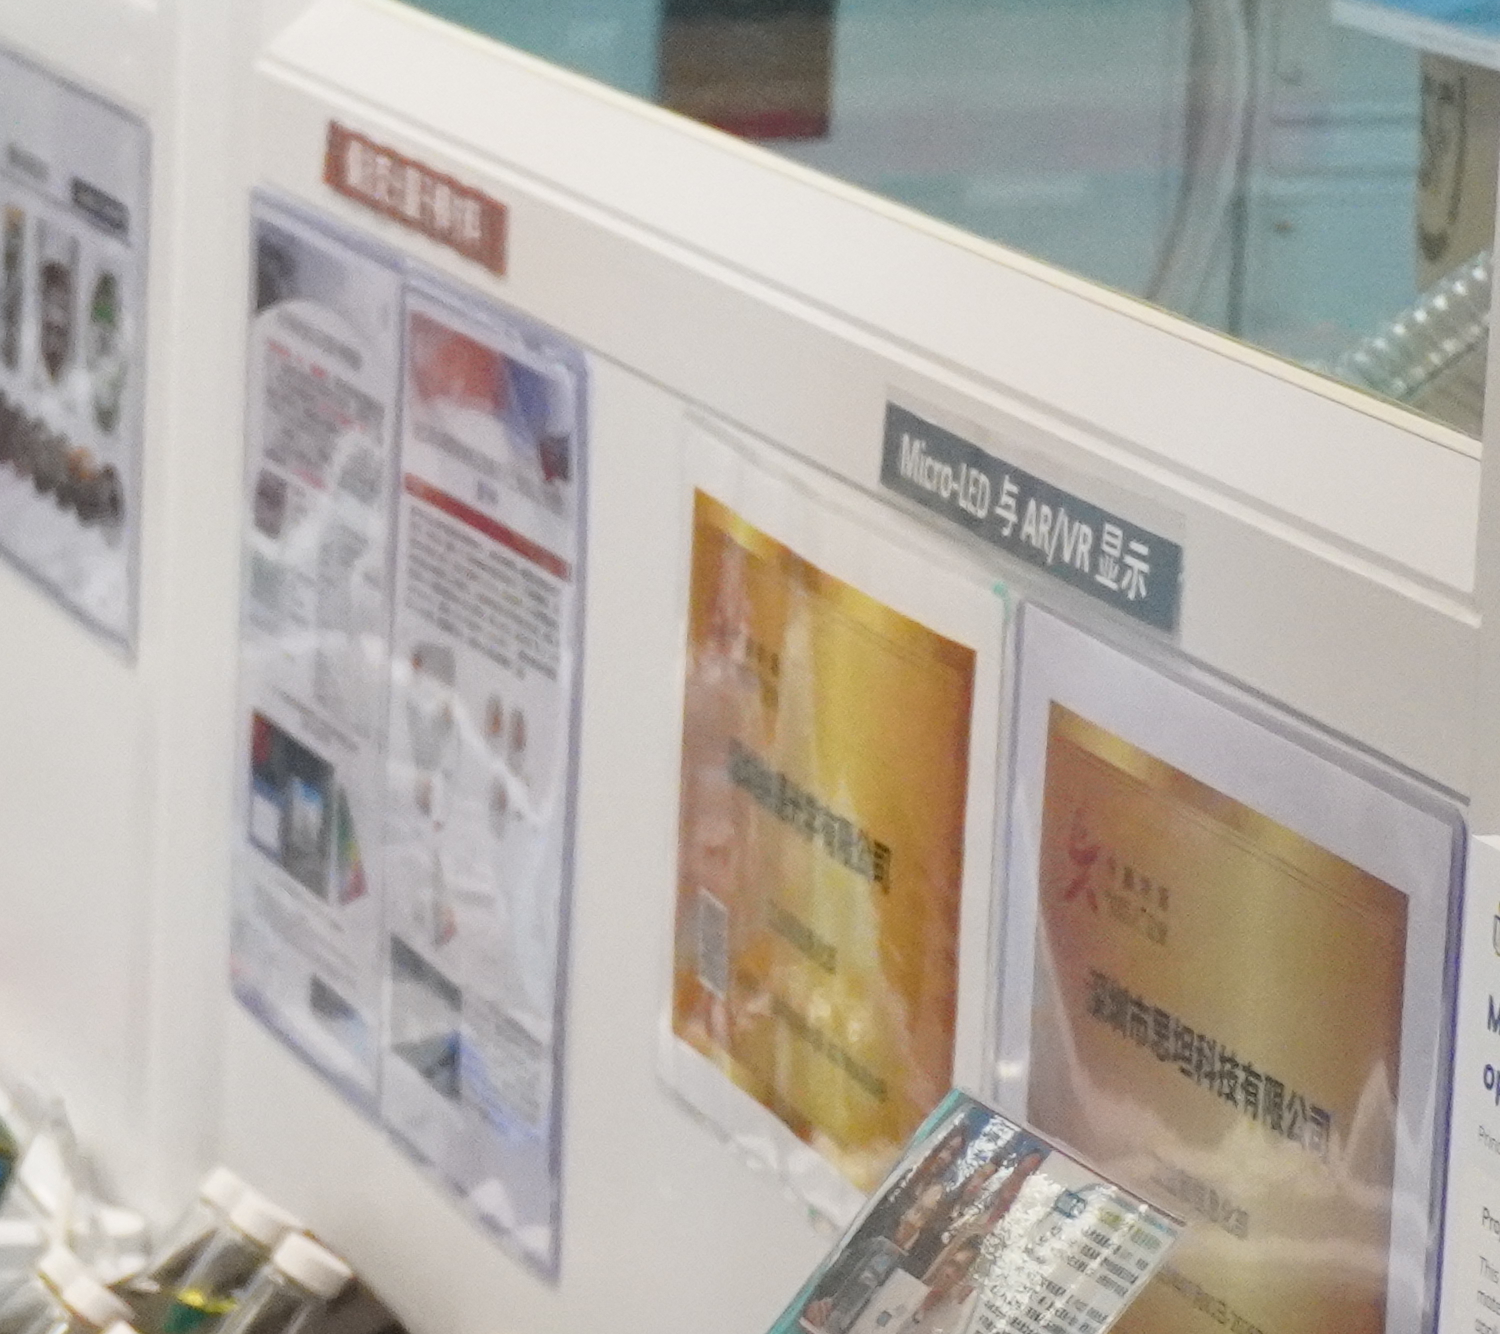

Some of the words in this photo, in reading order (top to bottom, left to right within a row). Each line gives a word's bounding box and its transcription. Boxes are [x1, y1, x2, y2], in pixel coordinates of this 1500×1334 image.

[900, 432, 990, 520] Micro-LED
[995, 474, 1020, 537] 与
[1020, 497, 1093, 573] AR/VR
[1095, 522, 1150, 601] 显示
